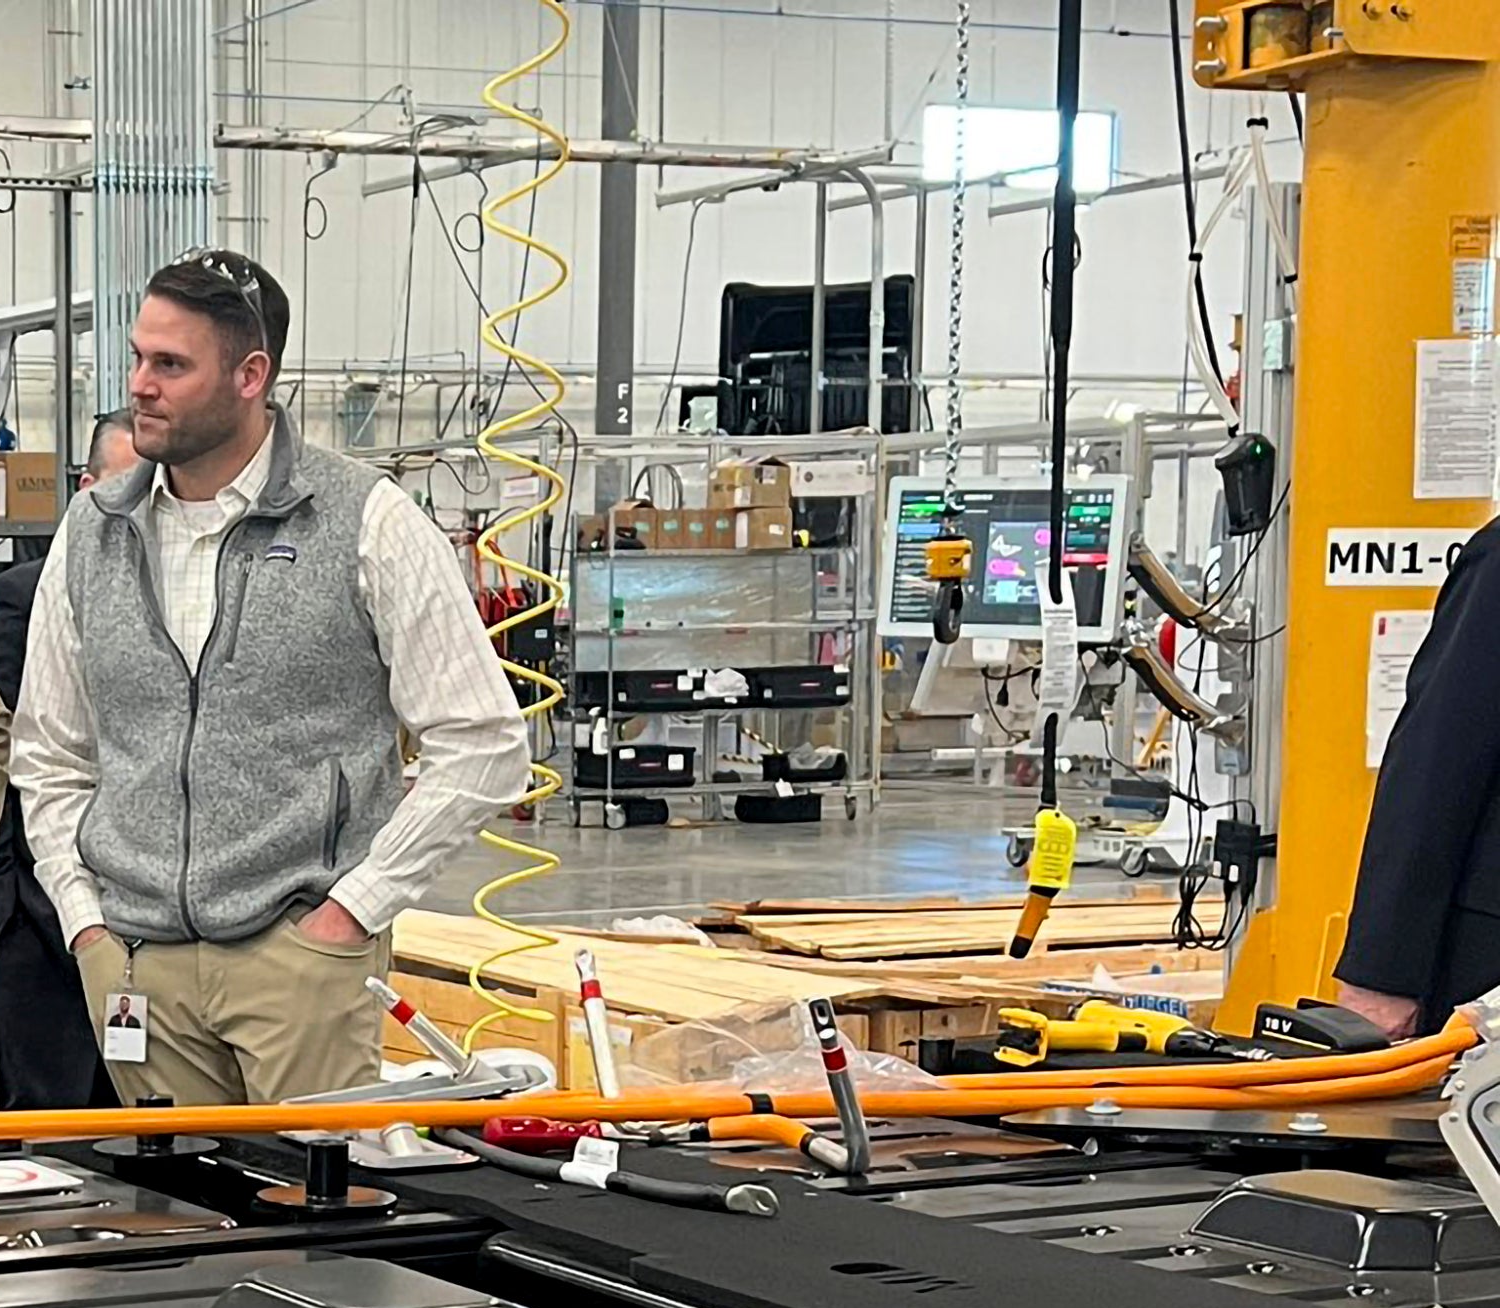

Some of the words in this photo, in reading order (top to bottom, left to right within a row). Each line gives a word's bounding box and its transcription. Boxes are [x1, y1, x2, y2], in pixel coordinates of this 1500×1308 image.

[617, 383, 629, 400] F
[617, 406, 628, 424] 2
[1265, 1016, 1280, 1031] 18
[1281, 1019, 1293, 1033] V
